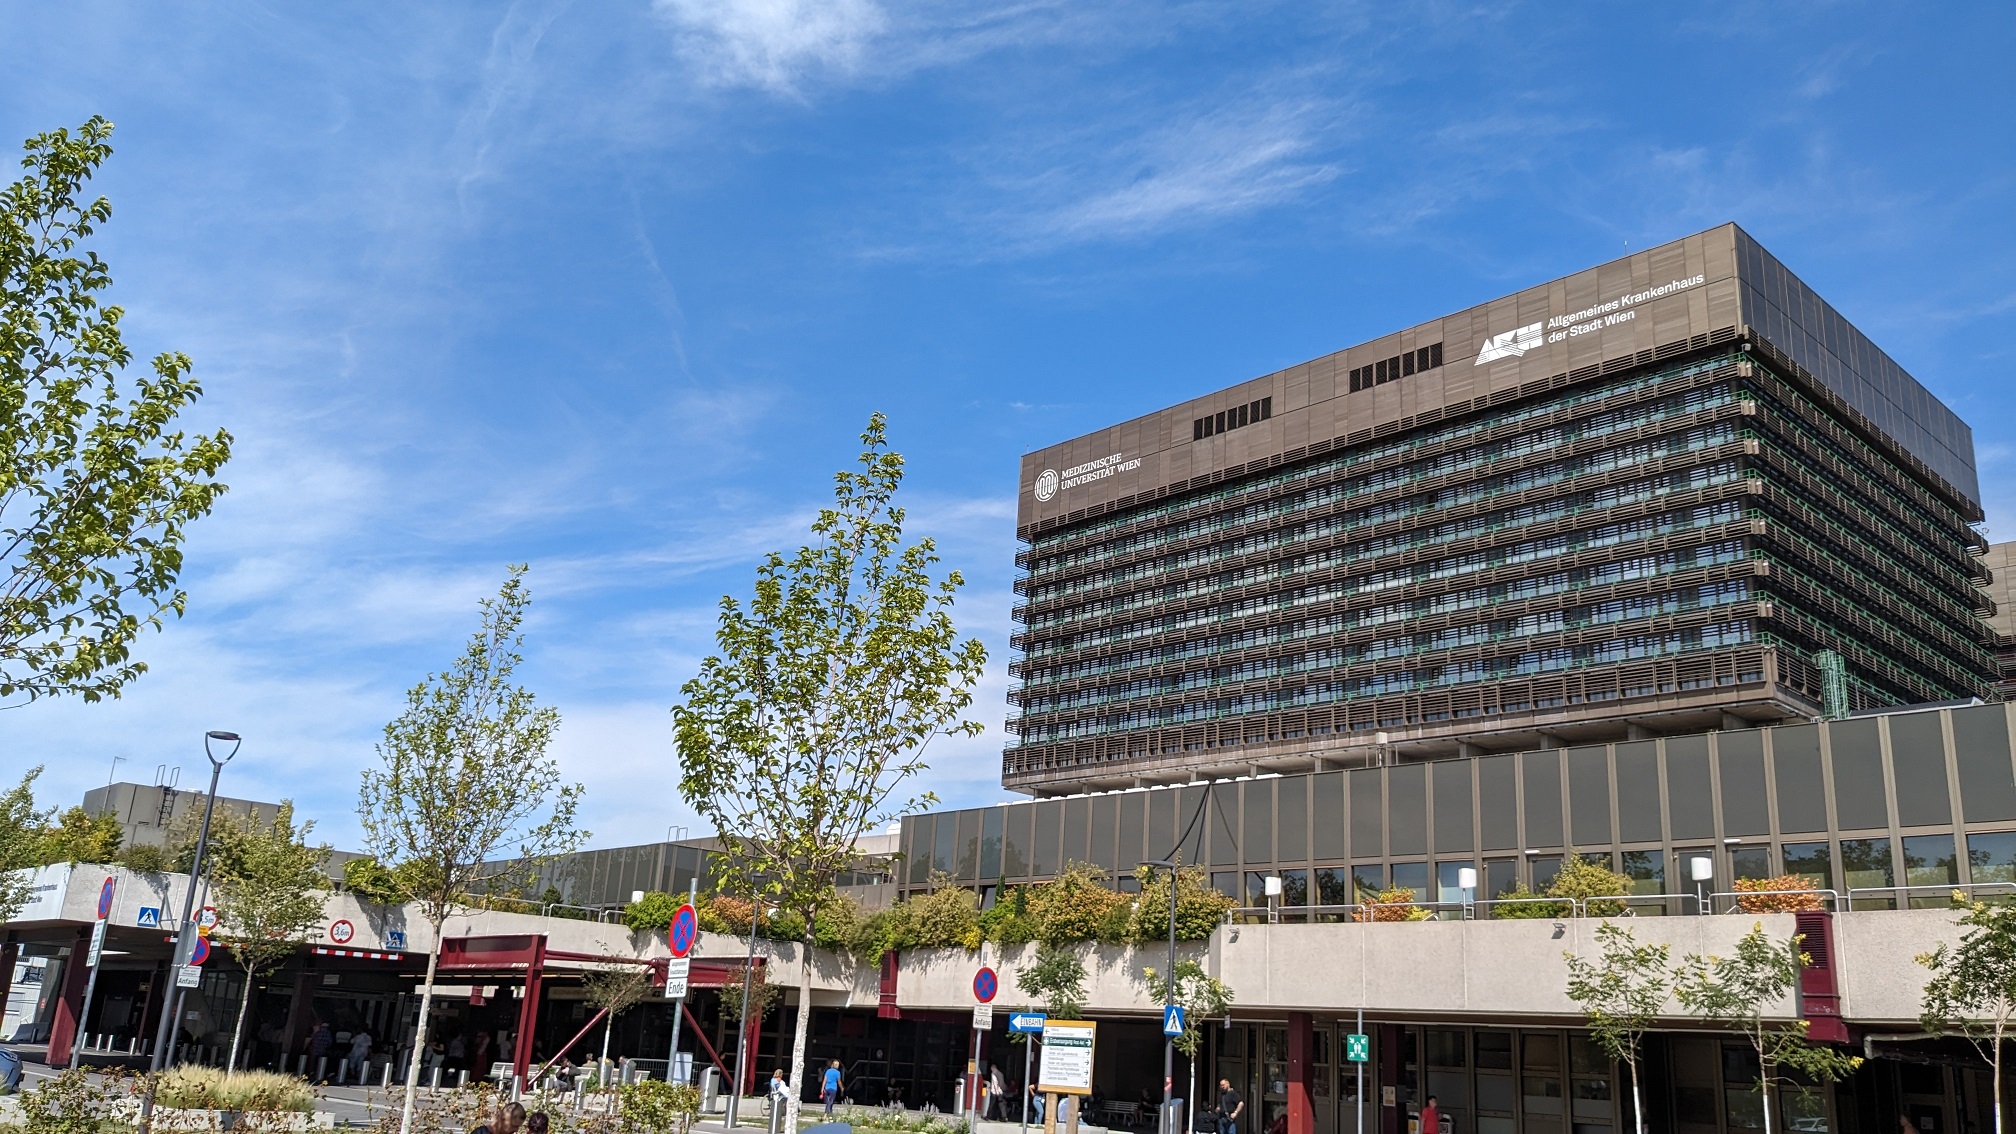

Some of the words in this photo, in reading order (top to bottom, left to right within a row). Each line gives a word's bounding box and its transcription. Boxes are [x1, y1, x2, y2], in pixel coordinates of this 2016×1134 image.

[1547, 300, 1619, 329] Allgemeines
[1621, 274, 1704, 307] Krankenhaus
[1548, 329, 1567, 344] der
[1569, 319, 1603, 337] Stadt
[1604, 310, 1635, 327] Wien
[1061, 453, 1122, 479] MEDIZINISCHE
[1061, 465, 1116, 490] UNIVERSITÄT
[1117, 458, 1142, 473] WIEN
[334, 926, 349, 937] 3,6m
[177, 978, 198, 986] Anfang
[668, 981, 684, 994] Ende
[974, 1018, 991, 1027] Anfang
[1020, 1018, 1042, 1026] EINBAHN
